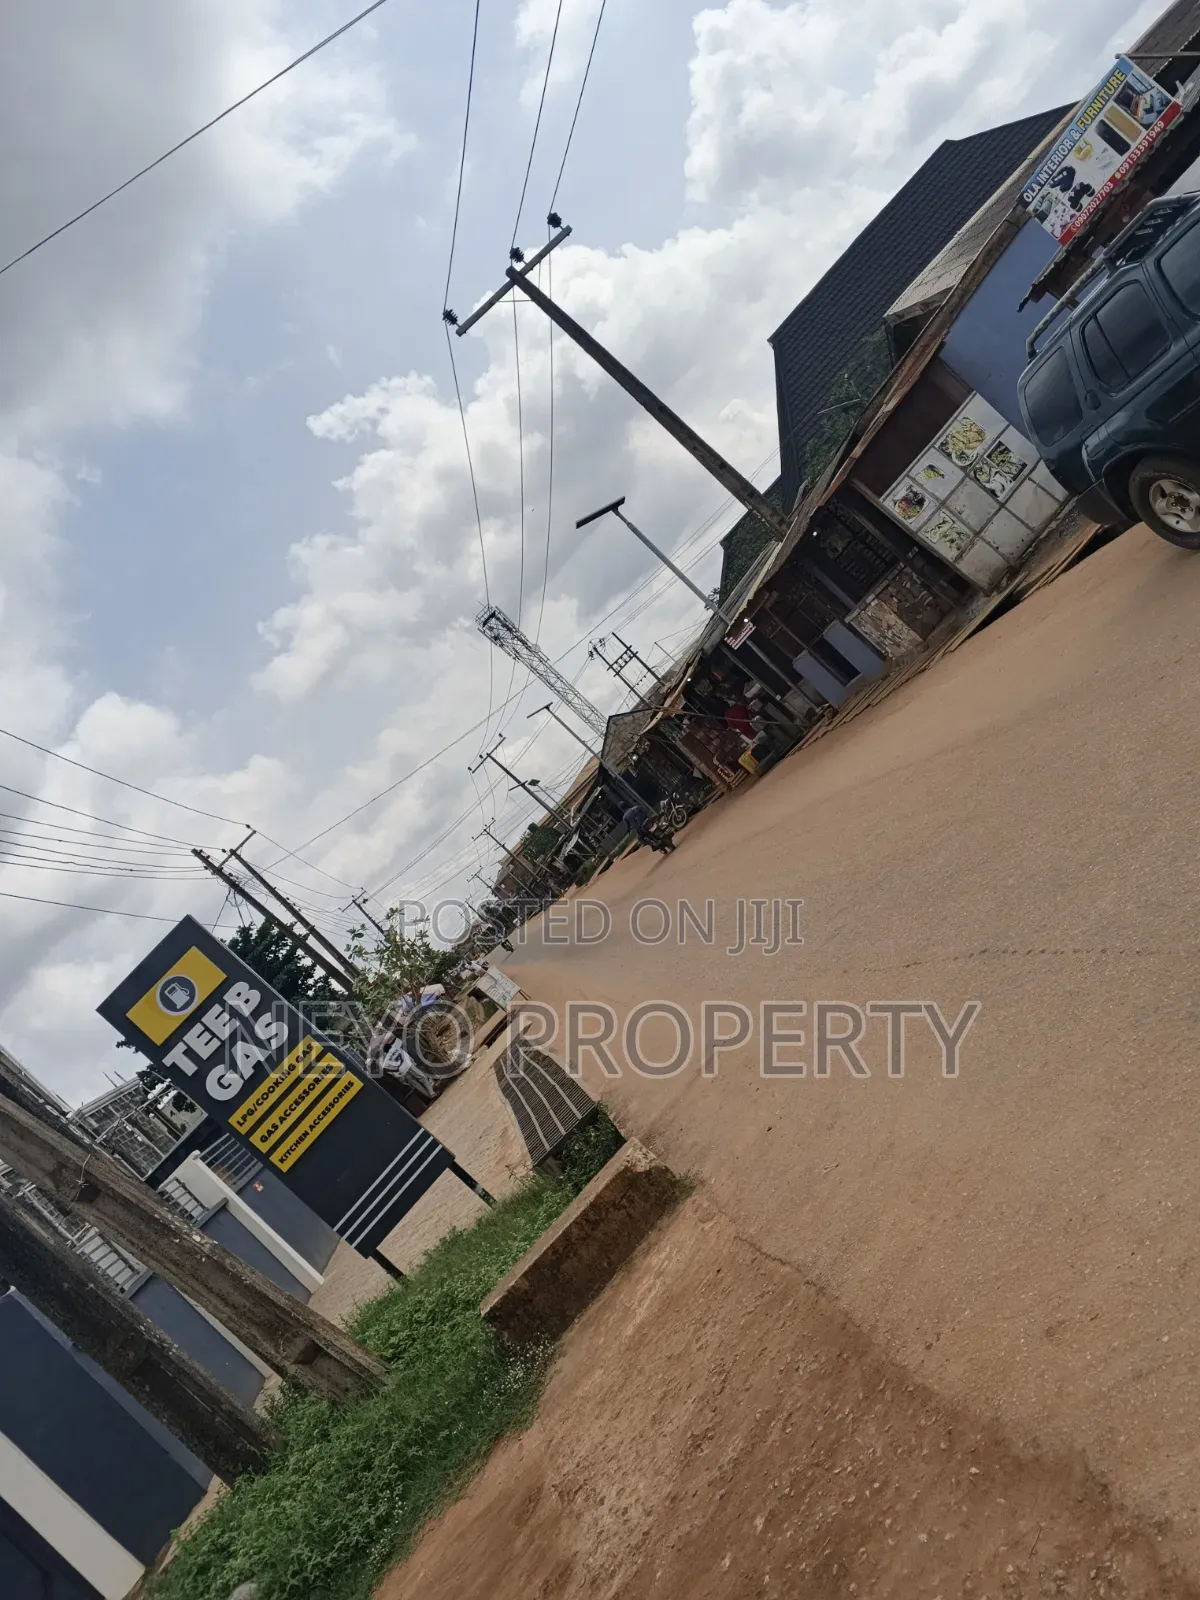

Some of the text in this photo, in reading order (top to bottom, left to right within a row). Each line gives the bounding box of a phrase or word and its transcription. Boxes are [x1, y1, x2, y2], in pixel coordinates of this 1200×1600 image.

[1023, 68, 1127, 203] OLA INTERIOR & FURNITURE
[161, 981, 262, 1077] TEEB
[205, 1012, 289, 1101] GAS
[236, 1043, 315, 1127] LPG/COOKING GAS
[260, 1063, 333, 1143] GAS ACCESSORIES
[278, 1080, 354, 1164] KITCHEN ACCESSORIES
